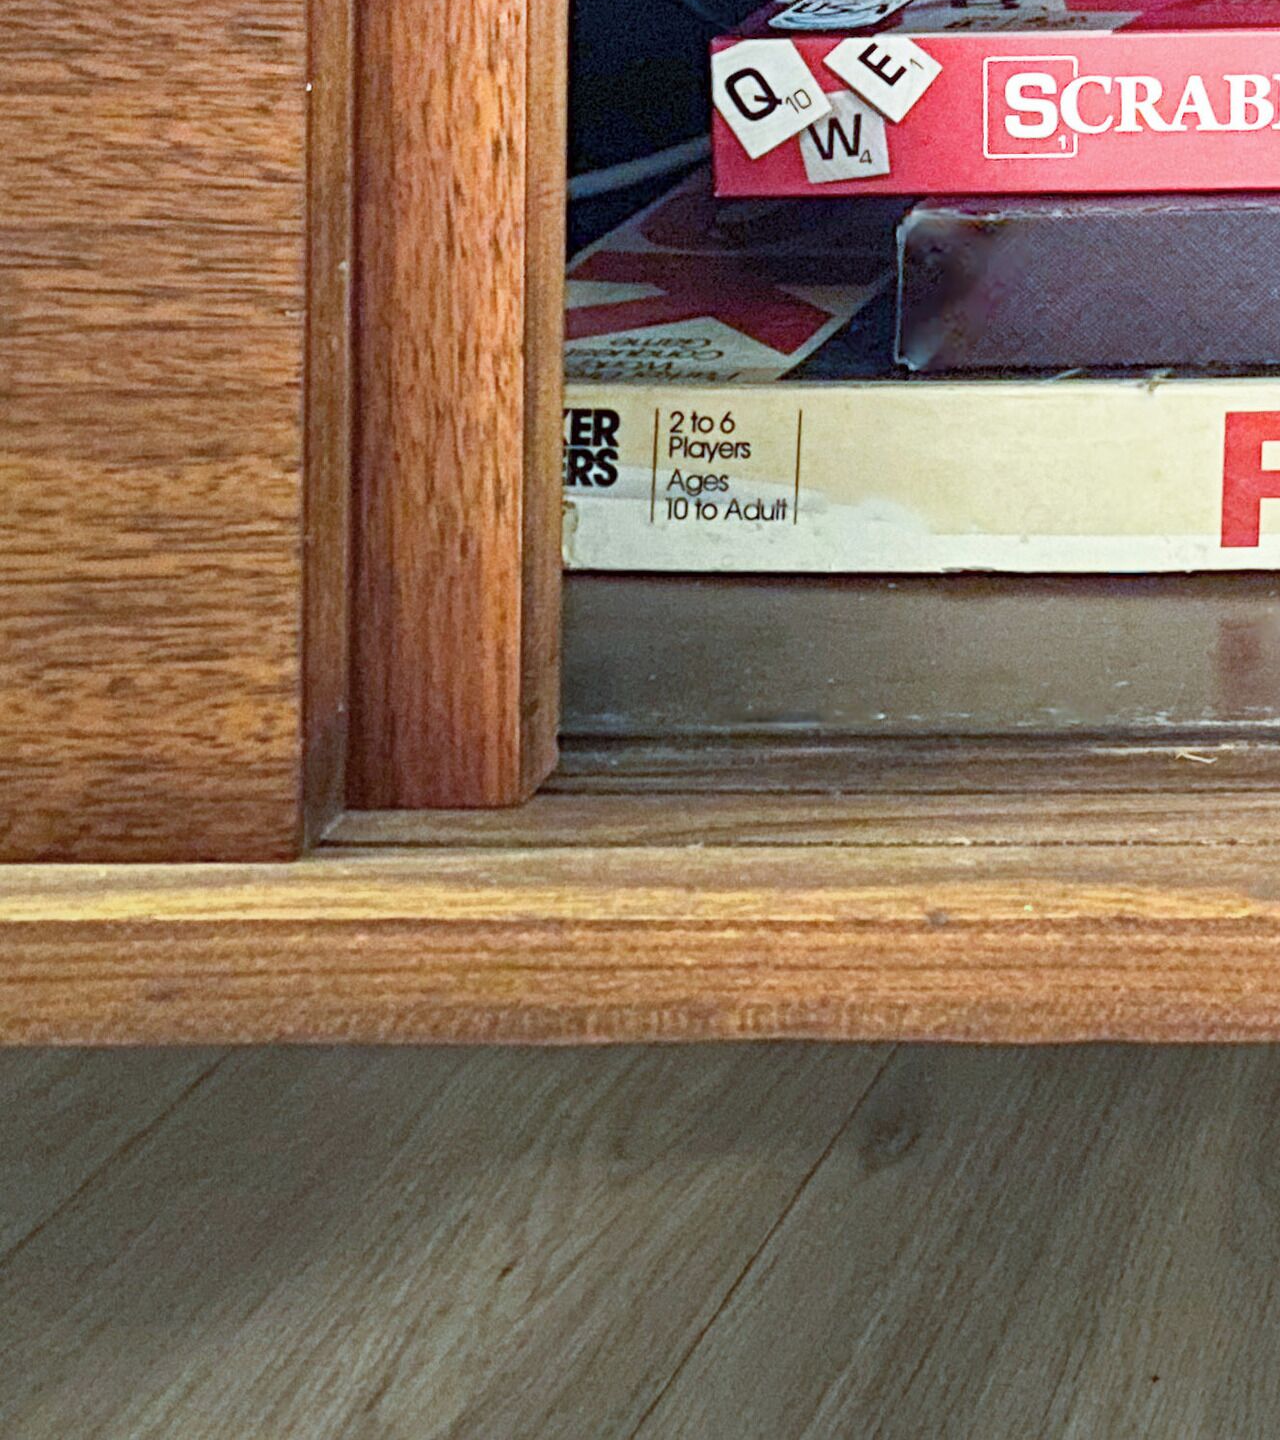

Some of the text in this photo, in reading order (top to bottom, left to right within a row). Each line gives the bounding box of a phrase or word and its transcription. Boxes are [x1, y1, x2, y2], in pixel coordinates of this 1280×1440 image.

[856, 42, 908, 88] E
[724, 67, 813, 122] Q 10
[807, 113, 873, 165] W 4
[669, 410, 736, 435] 2 to 6
[668, 436, 751, 463] Players
[666, 468, 730, 497] Ages
[665, 497, 788, 522] 10 to Adult
